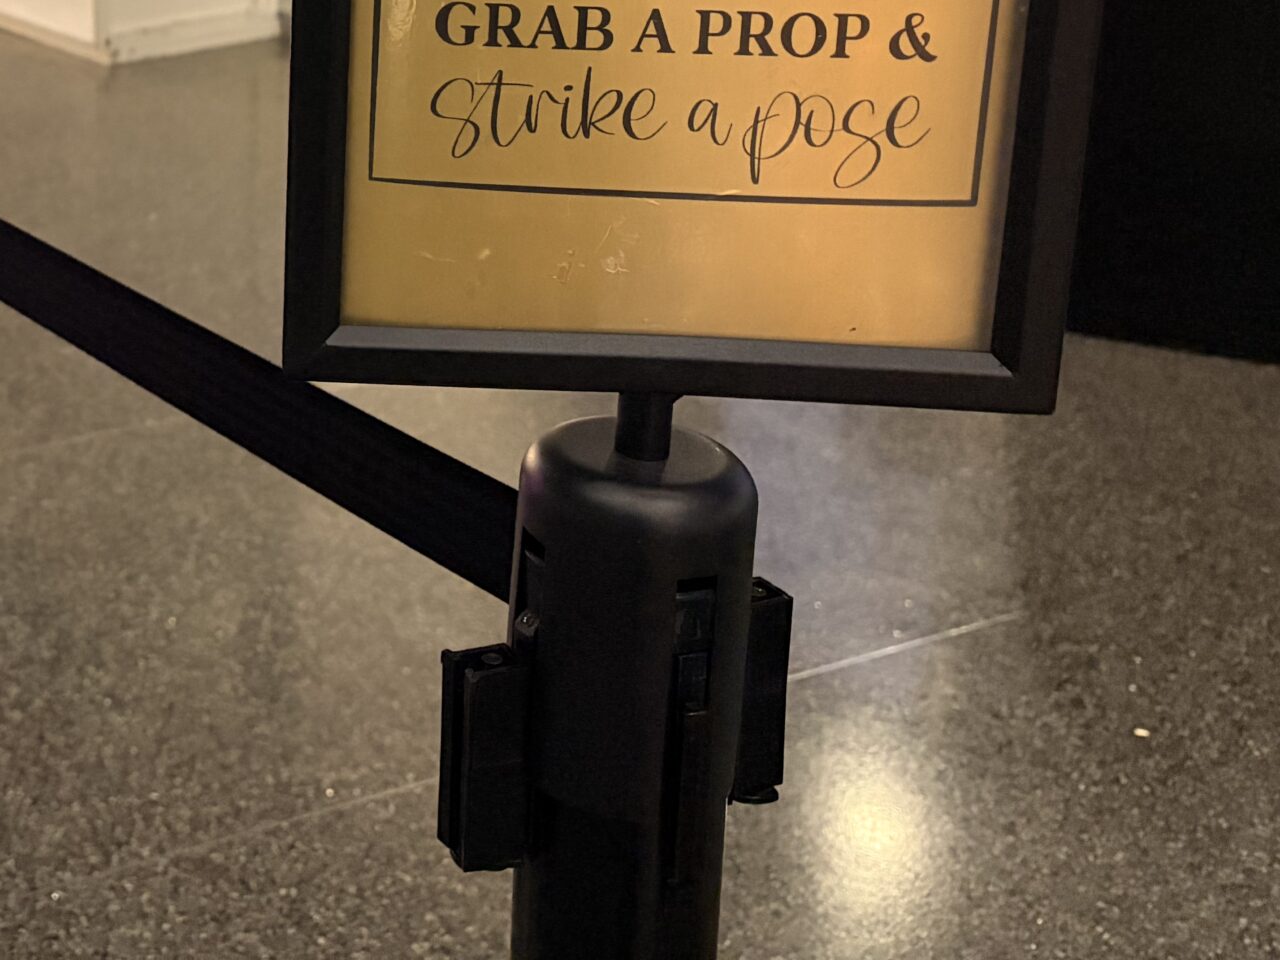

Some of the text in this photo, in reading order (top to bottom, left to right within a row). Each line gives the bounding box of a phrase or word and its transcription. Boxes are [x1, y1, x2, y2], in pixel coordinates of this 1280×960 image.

[434, 1, 938, 62] GRAB A PROP &
[429, 66, 932, 190] strike a pose
